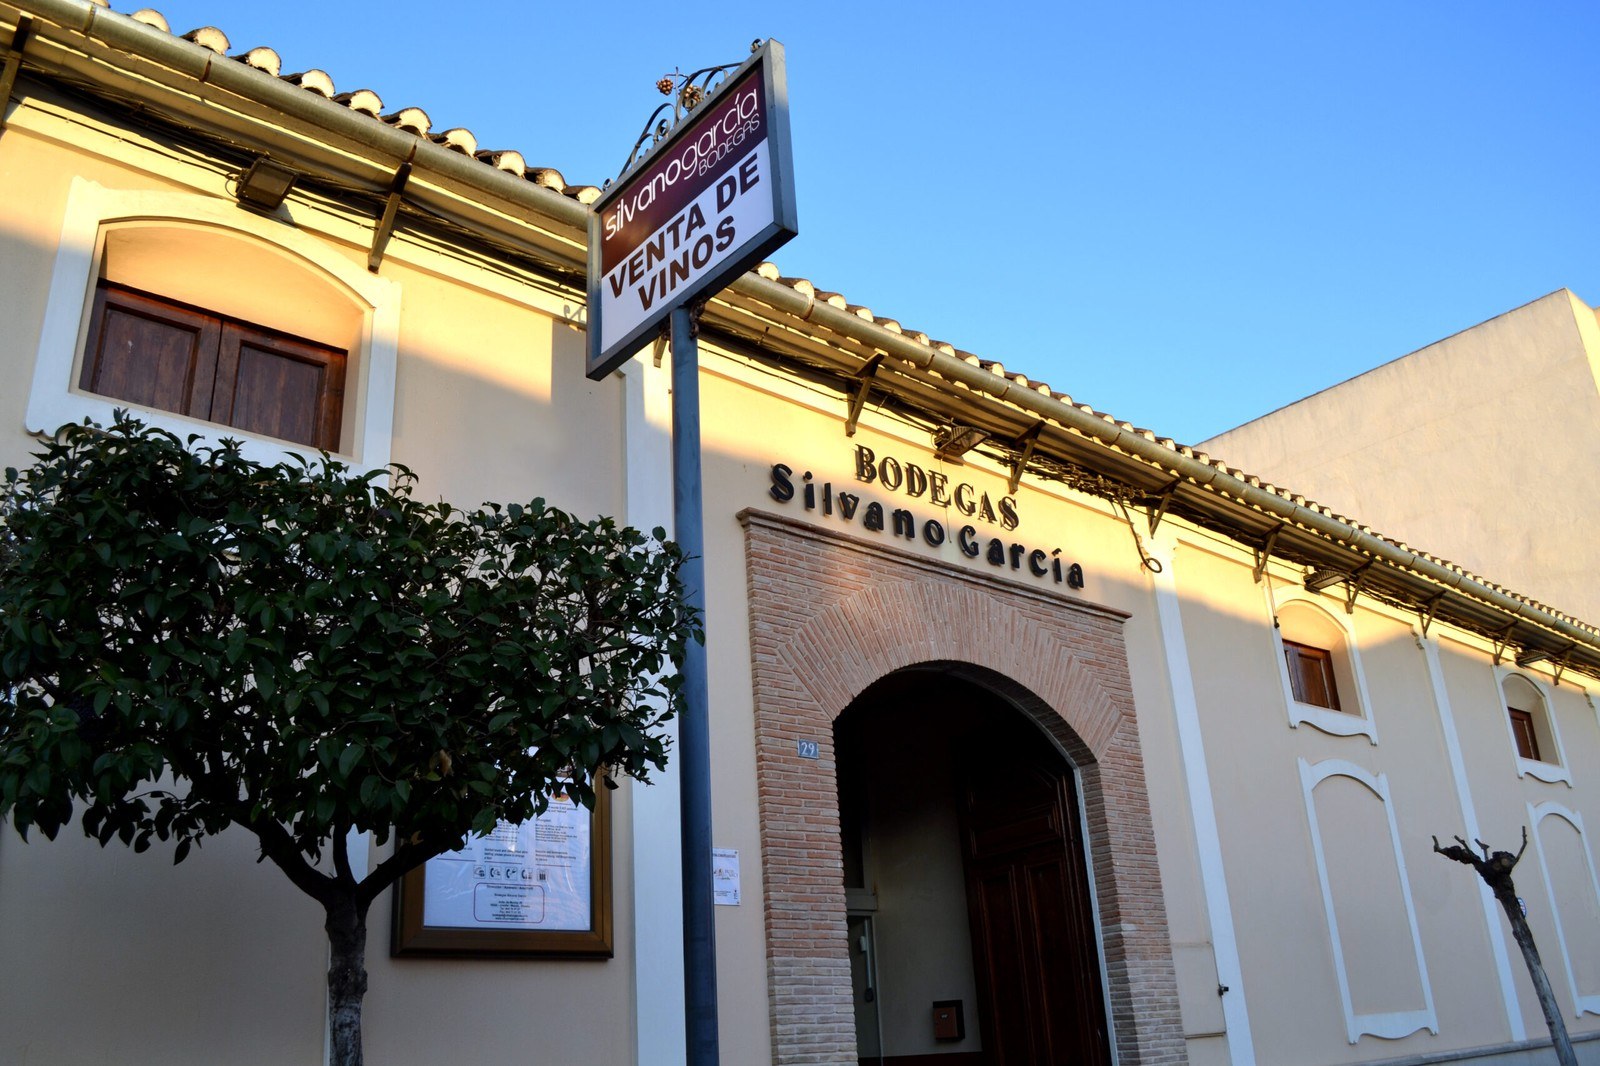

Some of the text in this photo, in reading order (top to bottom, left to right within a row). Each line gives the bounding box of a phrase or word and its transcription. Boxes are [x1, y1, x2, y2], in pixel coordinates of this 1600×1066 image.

[698, 113, 761, 177] BODEGAS
[608, 152, 761, 299] VENTA DE
[637, 215, 736, 312] VINOS
[769, 462, 1085, 589] Silvano García
[853, 443, 1020, 532] BODEGAS
[800, 741, 815, 756] 29
